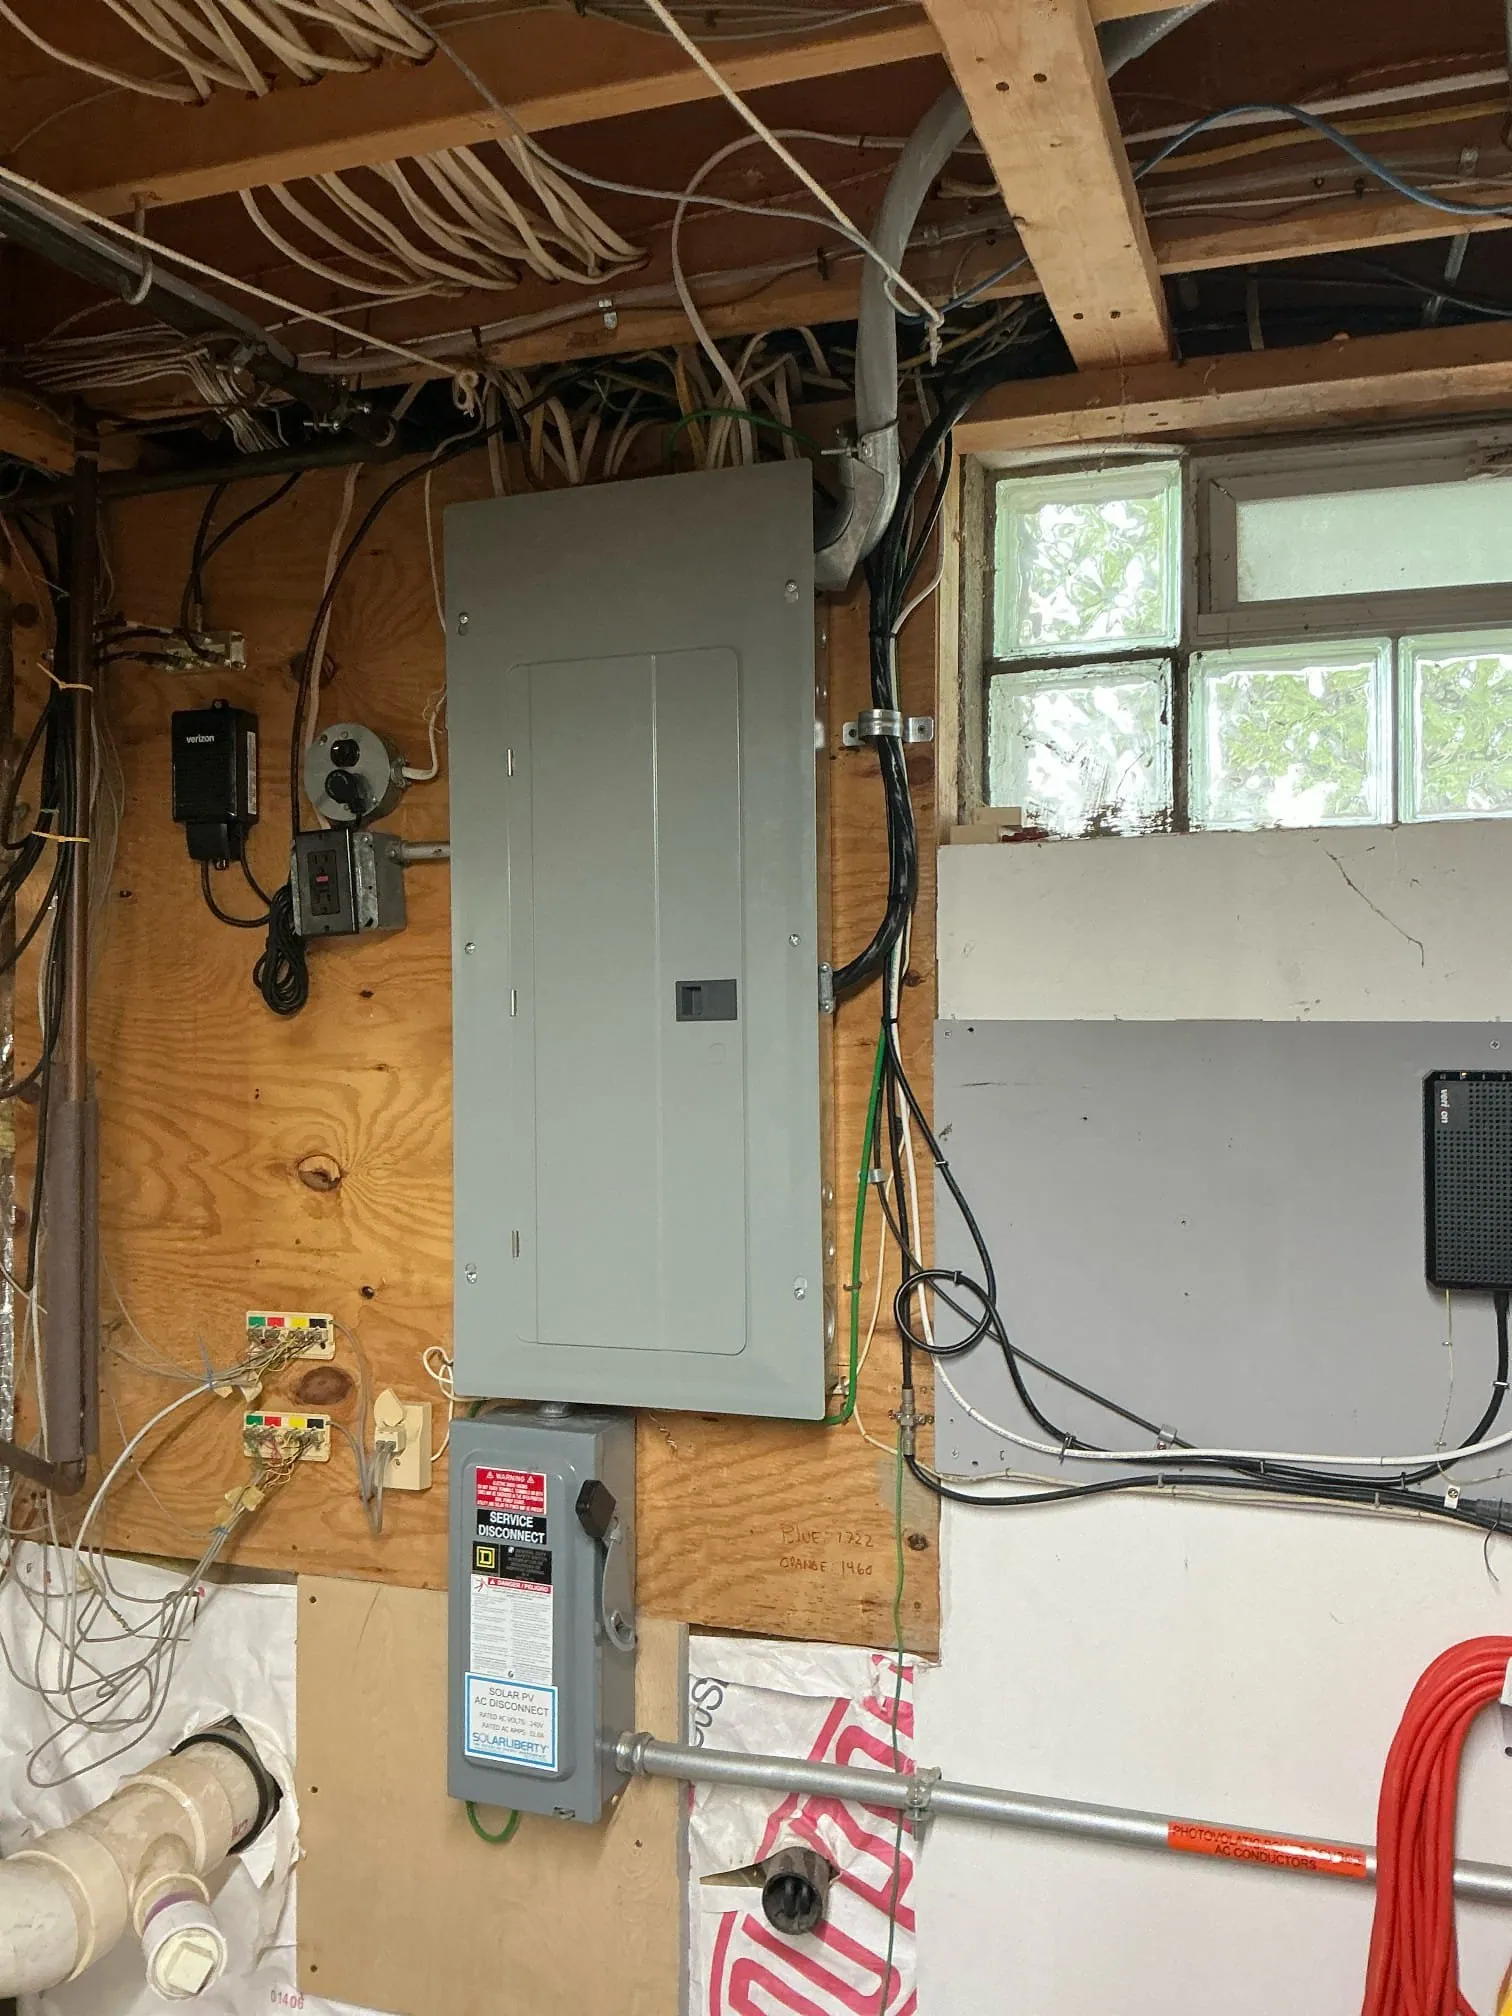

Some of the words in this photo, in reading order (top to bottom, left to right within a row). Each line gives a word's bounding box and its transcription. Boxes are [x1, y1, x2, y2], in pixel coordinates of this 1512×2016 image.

[186, 734, 215, 743] verizon
[495, 1473, 526, 1482] WARNING
[489, 1511, 534, 1528] SERVICE
[478, 1524, 546, 1544] DISCONNECT
[838, 1531, 874, 1547] 1722
[489, 1687, 520, 1700] SOLAR
[521, 1693, 535, 1702] PV
[474, 1696, 487, 1706] AC
[489, 1699, 549, 1717] DISCONNECT
[472, 1732, 547, 1754] SOLARLIBERTY
[1214, 1845, 1231, 1857] AC
[1234, 1847, 1317, 1870] CONDUCTORS
